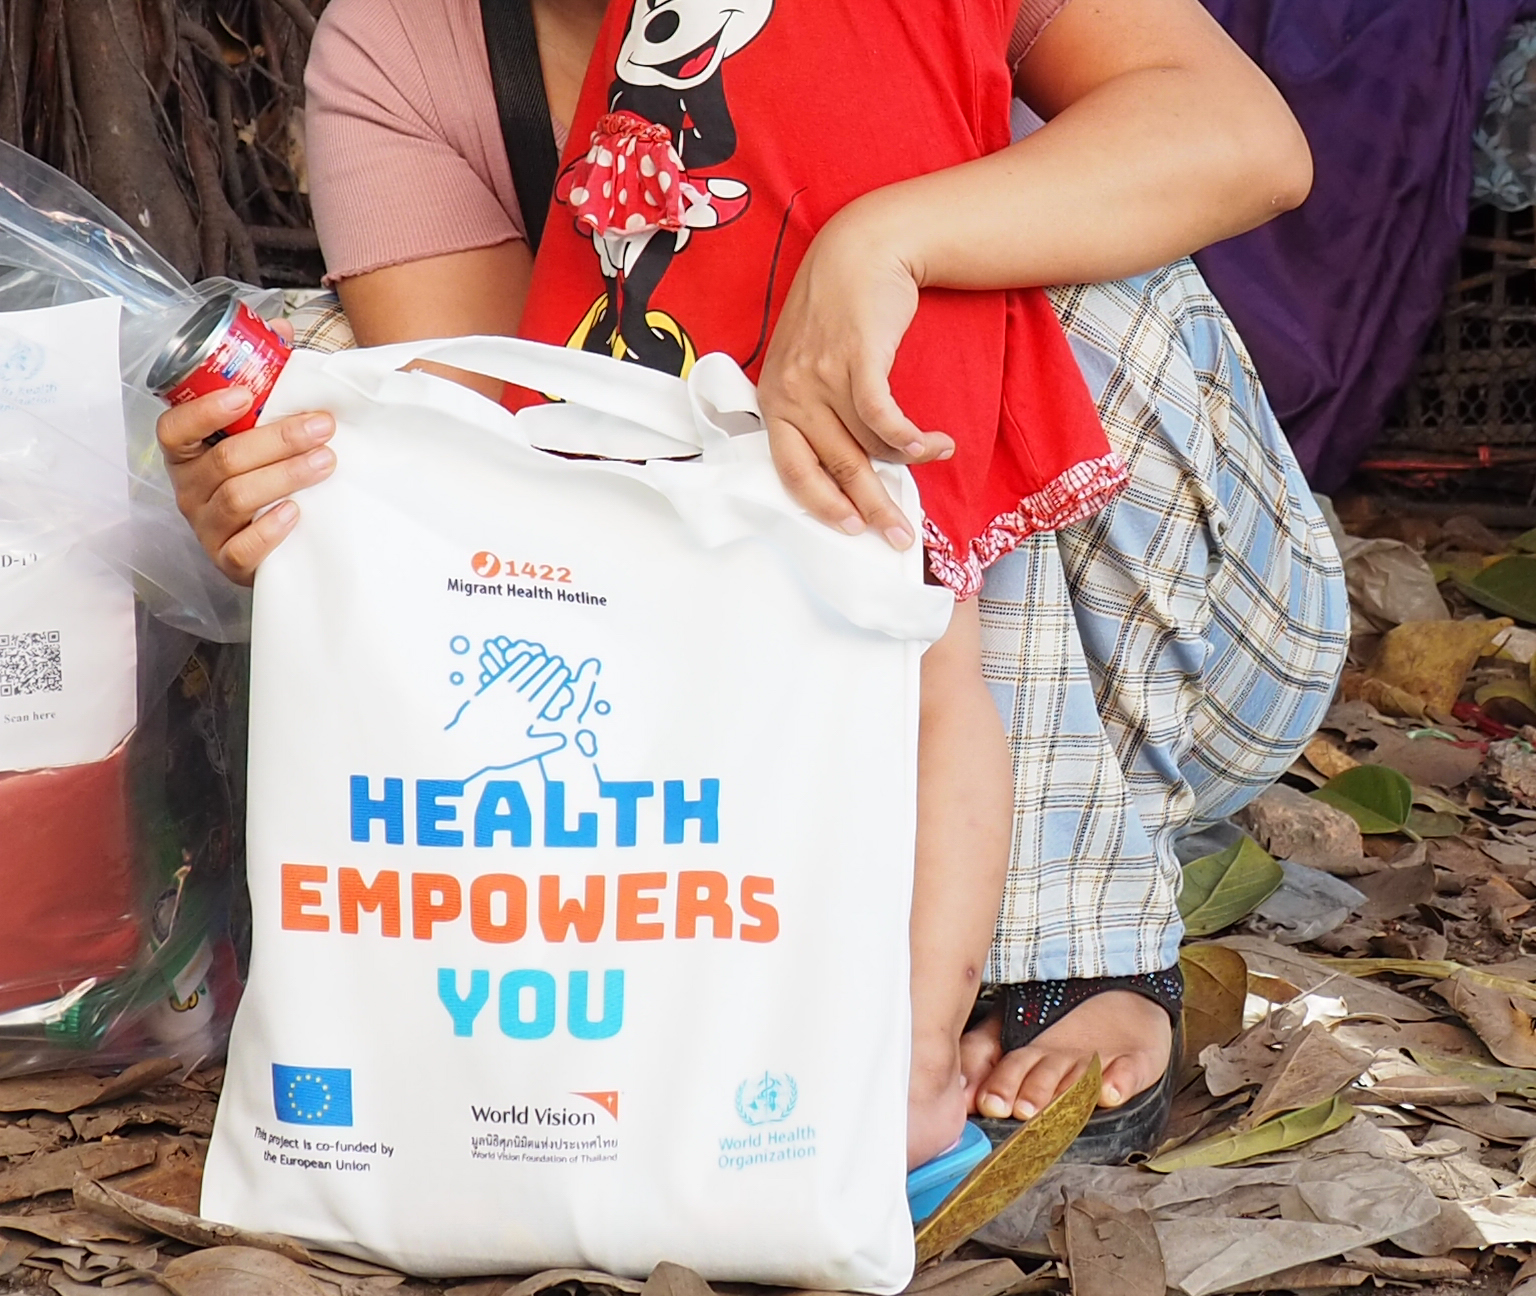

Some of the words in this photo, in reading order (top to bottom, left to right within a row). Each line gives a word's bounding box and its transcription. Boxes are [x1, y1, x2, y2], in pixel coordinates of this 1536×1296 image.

[505, 560, 573, 584] 1422
[447, 577, 503, 596] Migrant
[507, 584, 554, 601] Health
[557, 589, 608, 606] Hotline
[3, 714, 30, 724] Scan
[32, 711, 57, 721] here
[349, 774, 720, 847] HEALTH
[280, 863, 780, 945] EMPOWERS
[437, 968, 625, 1040] YOU
[471, 1105, 529, 1125] World
[534, 1107, 596, 1126] Vision
[254, 1126, 267, 1142] This
[267, 1133, 300, 1150] project
[303, 1139, 313, 1151] is
[315, 1140, 378, 1154] co-funded
[380, 1142, 395, 1158] by
[718, 1133, 762, 1151] World
[767, 1125, 817, 1145] Health
[263, 1149, 278, 1164] the
[279, 1153, 332, 1170] European
[335, 1160, 371, 1172] Union
[471, 1150, 496, 1160] World
[496, 1151, 520, 1162] Vision
[522, 1153, 568, 1164] Foundation
[581, 1154, 618, 1163] Thailand
[718, 1145, 817, 1170] Organization
